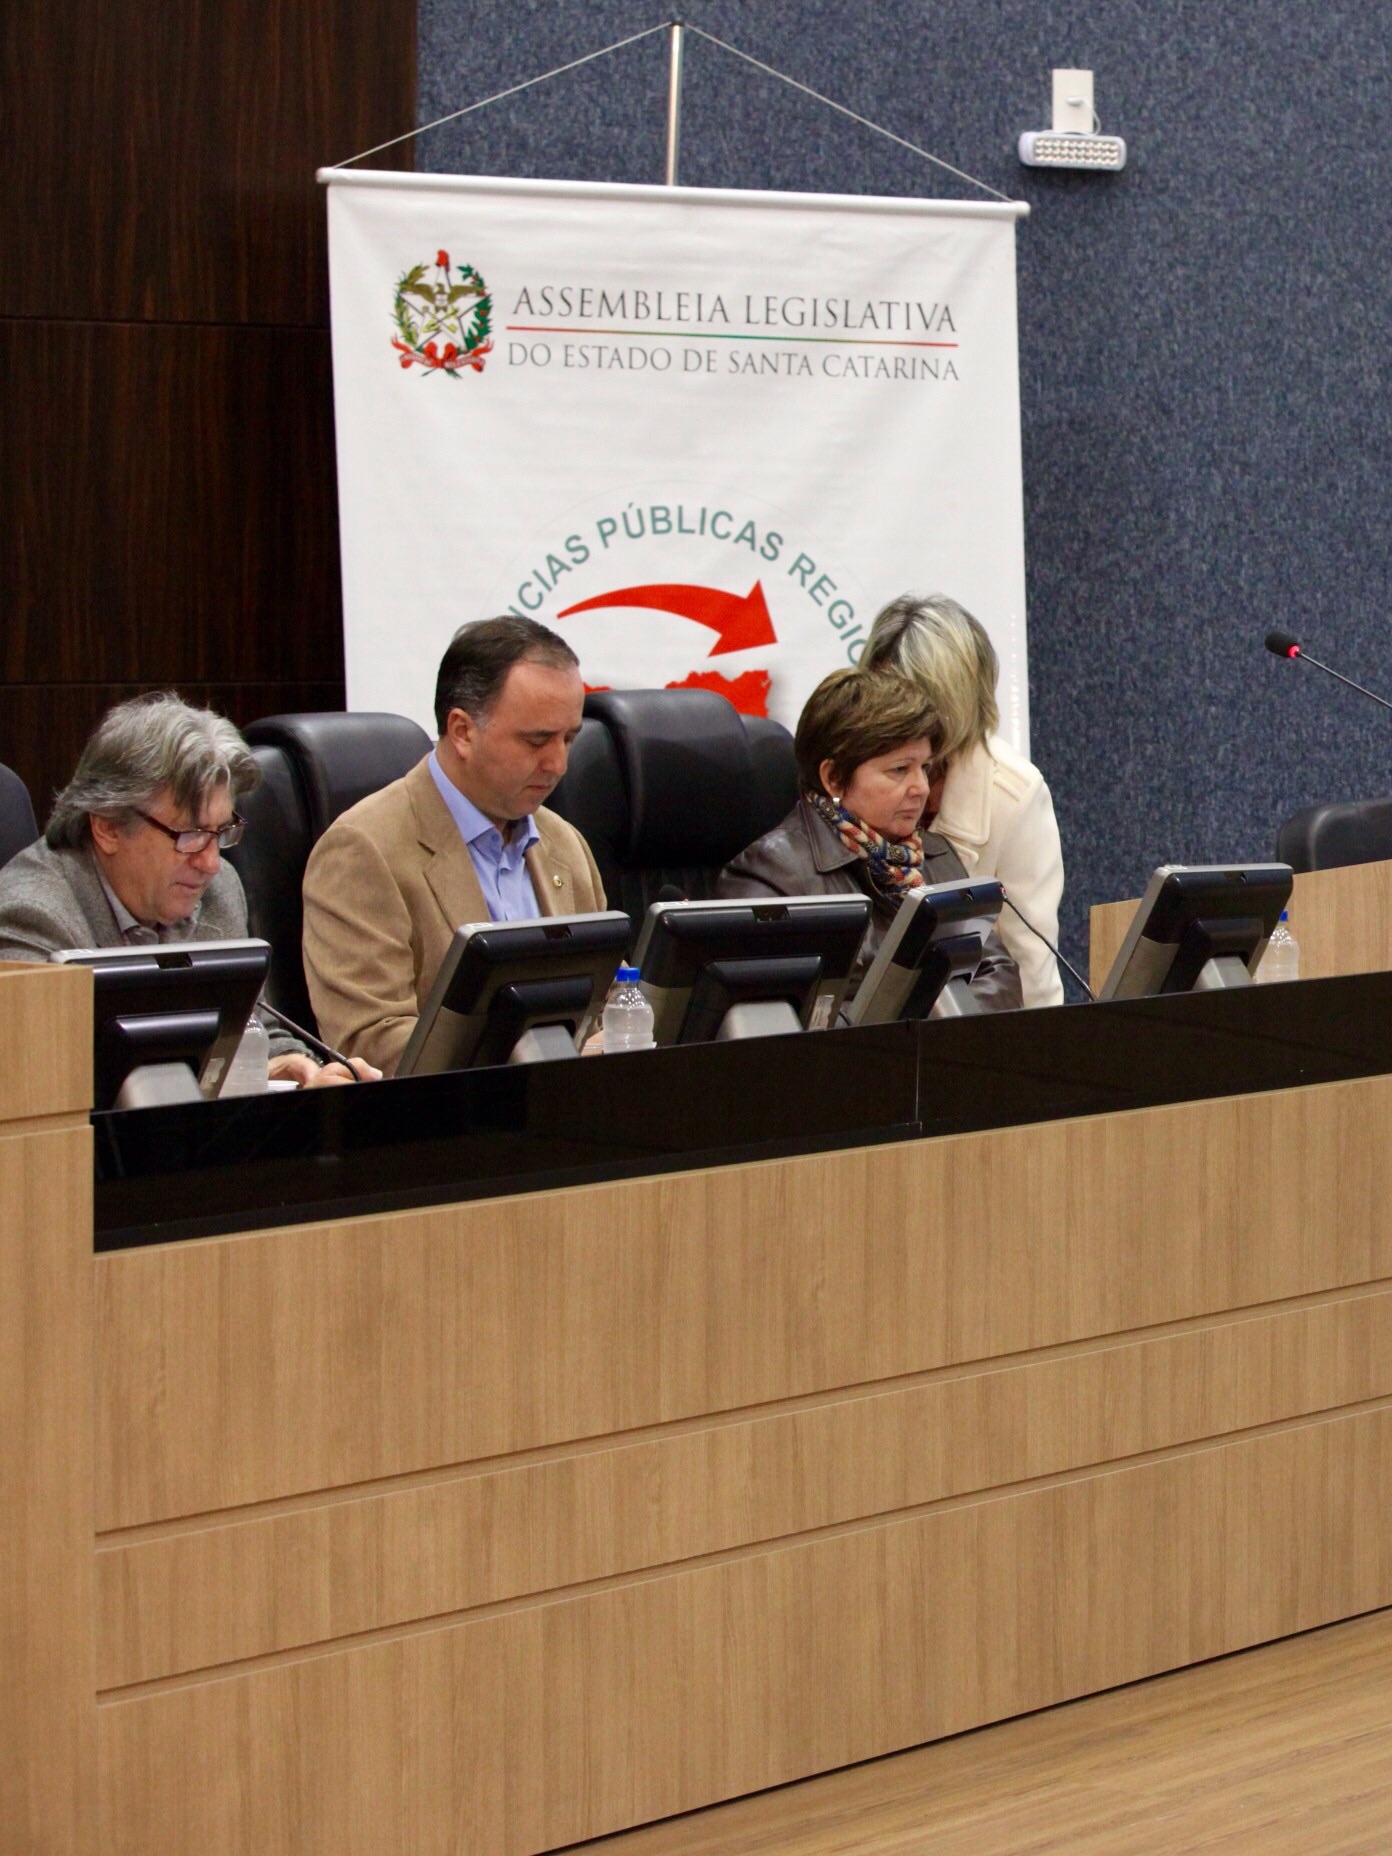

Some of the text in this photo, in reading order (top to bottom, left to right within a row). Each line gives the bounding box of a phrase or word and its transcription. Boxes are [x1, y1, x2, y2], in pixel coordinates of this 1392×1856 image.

[512, 285, 958, 333] ASSEMBLEIA LEGISLATIVA
[507, 341, 552, 368] DO
[562, 343, 673, 372] ESTADO
[682, 348, 719, 374] DE
[728, 349, 814, 377] SANTA
[821, 353, 960, 381] CATARINA
[595, 501, 785, 563] PÚBLICAS
